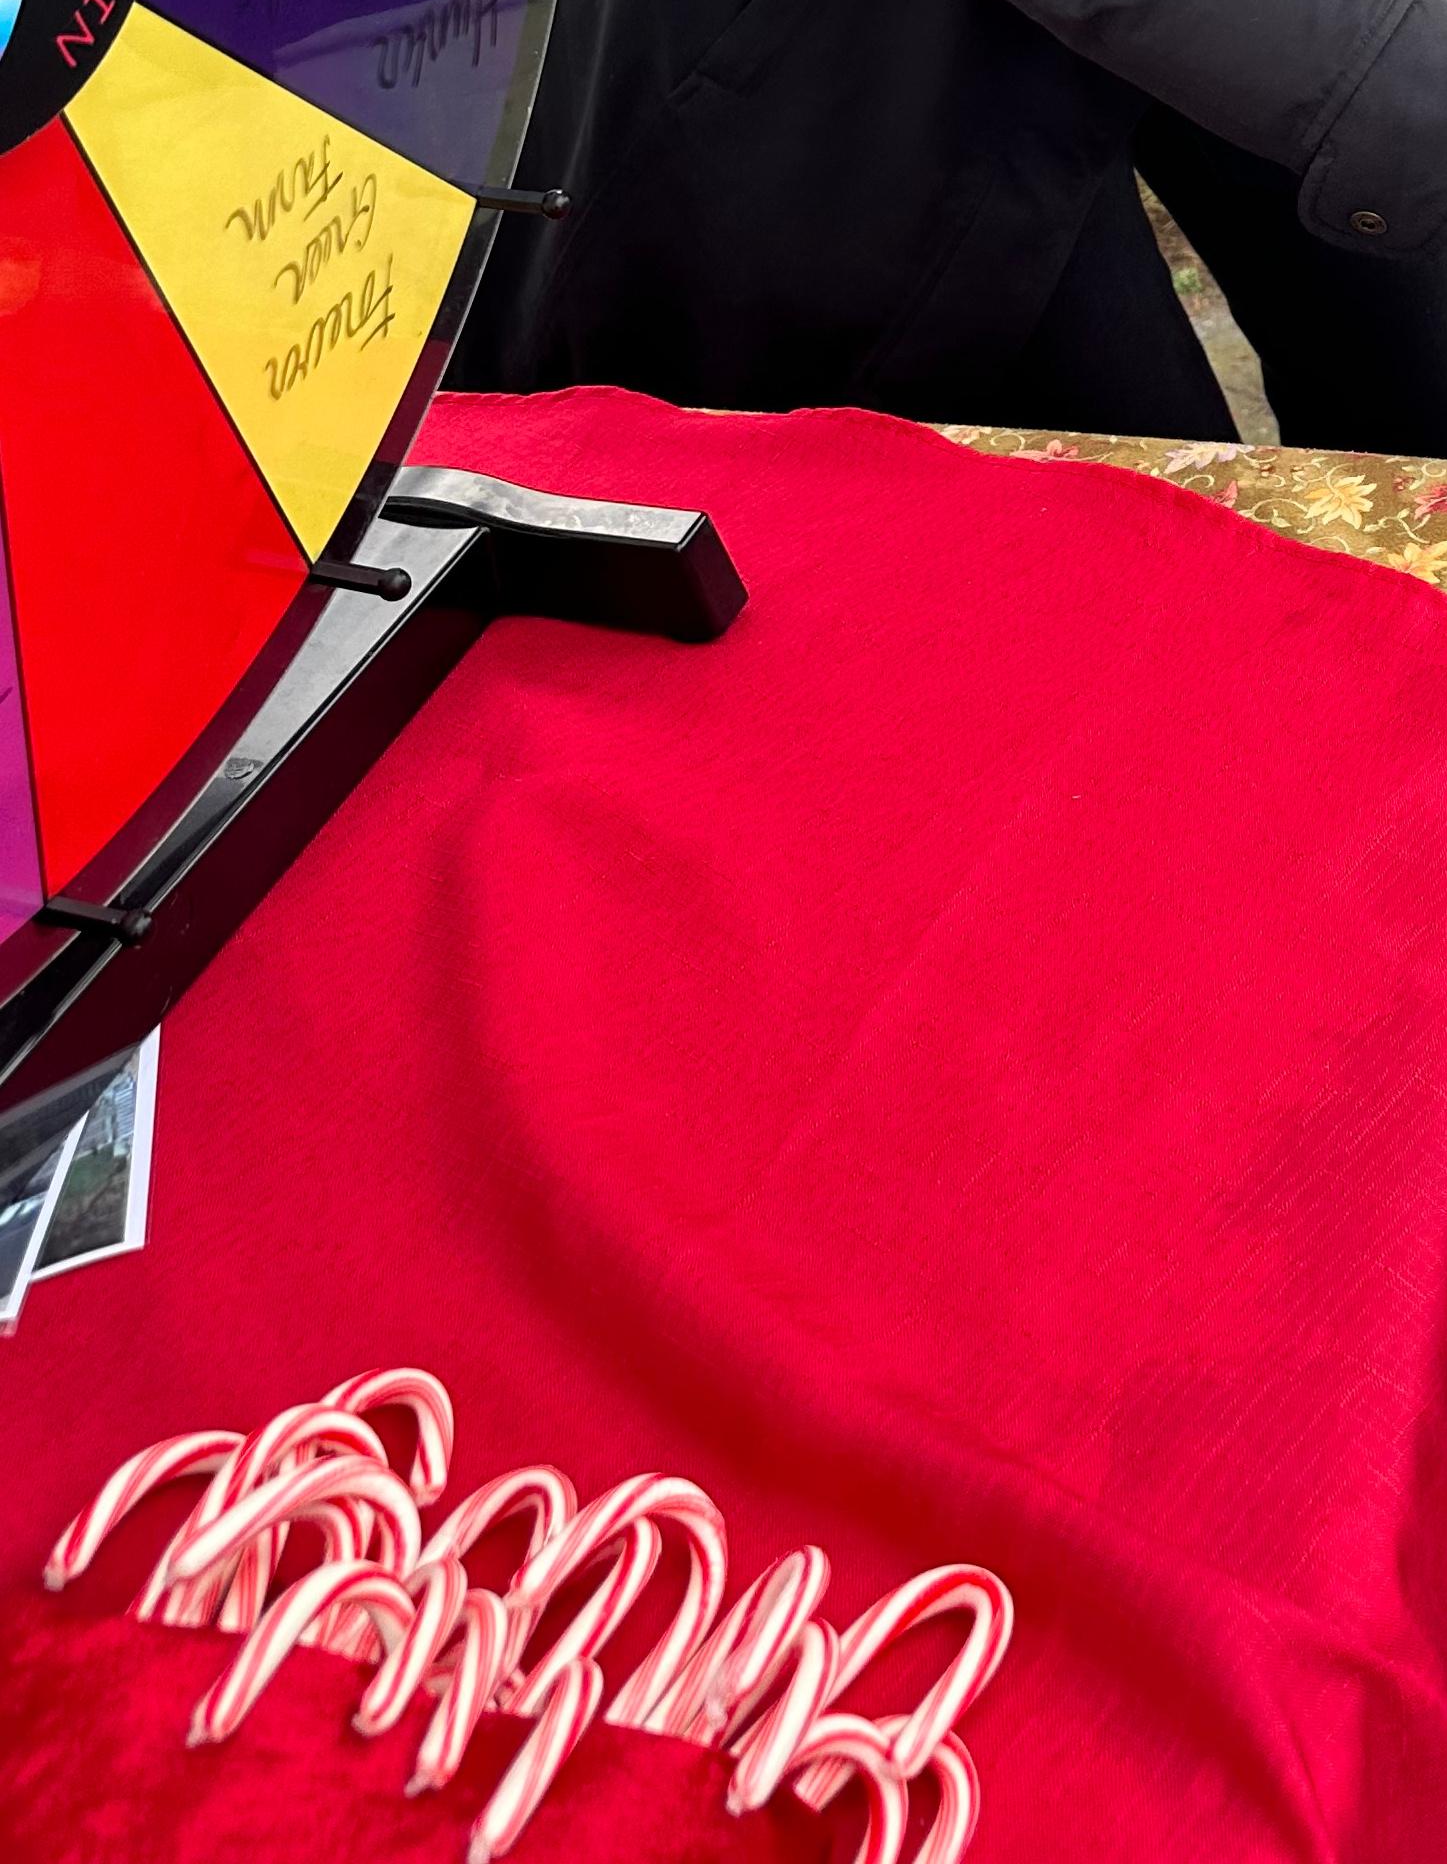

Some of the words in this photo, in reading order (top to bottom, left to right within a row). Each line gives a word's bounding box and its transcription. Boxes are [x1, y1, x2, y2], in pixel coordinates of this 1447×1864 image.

[224, 133, 344, 241] Farm
[272, 172, 377, 305] Green
[264, 251, 396, 403] Forever
